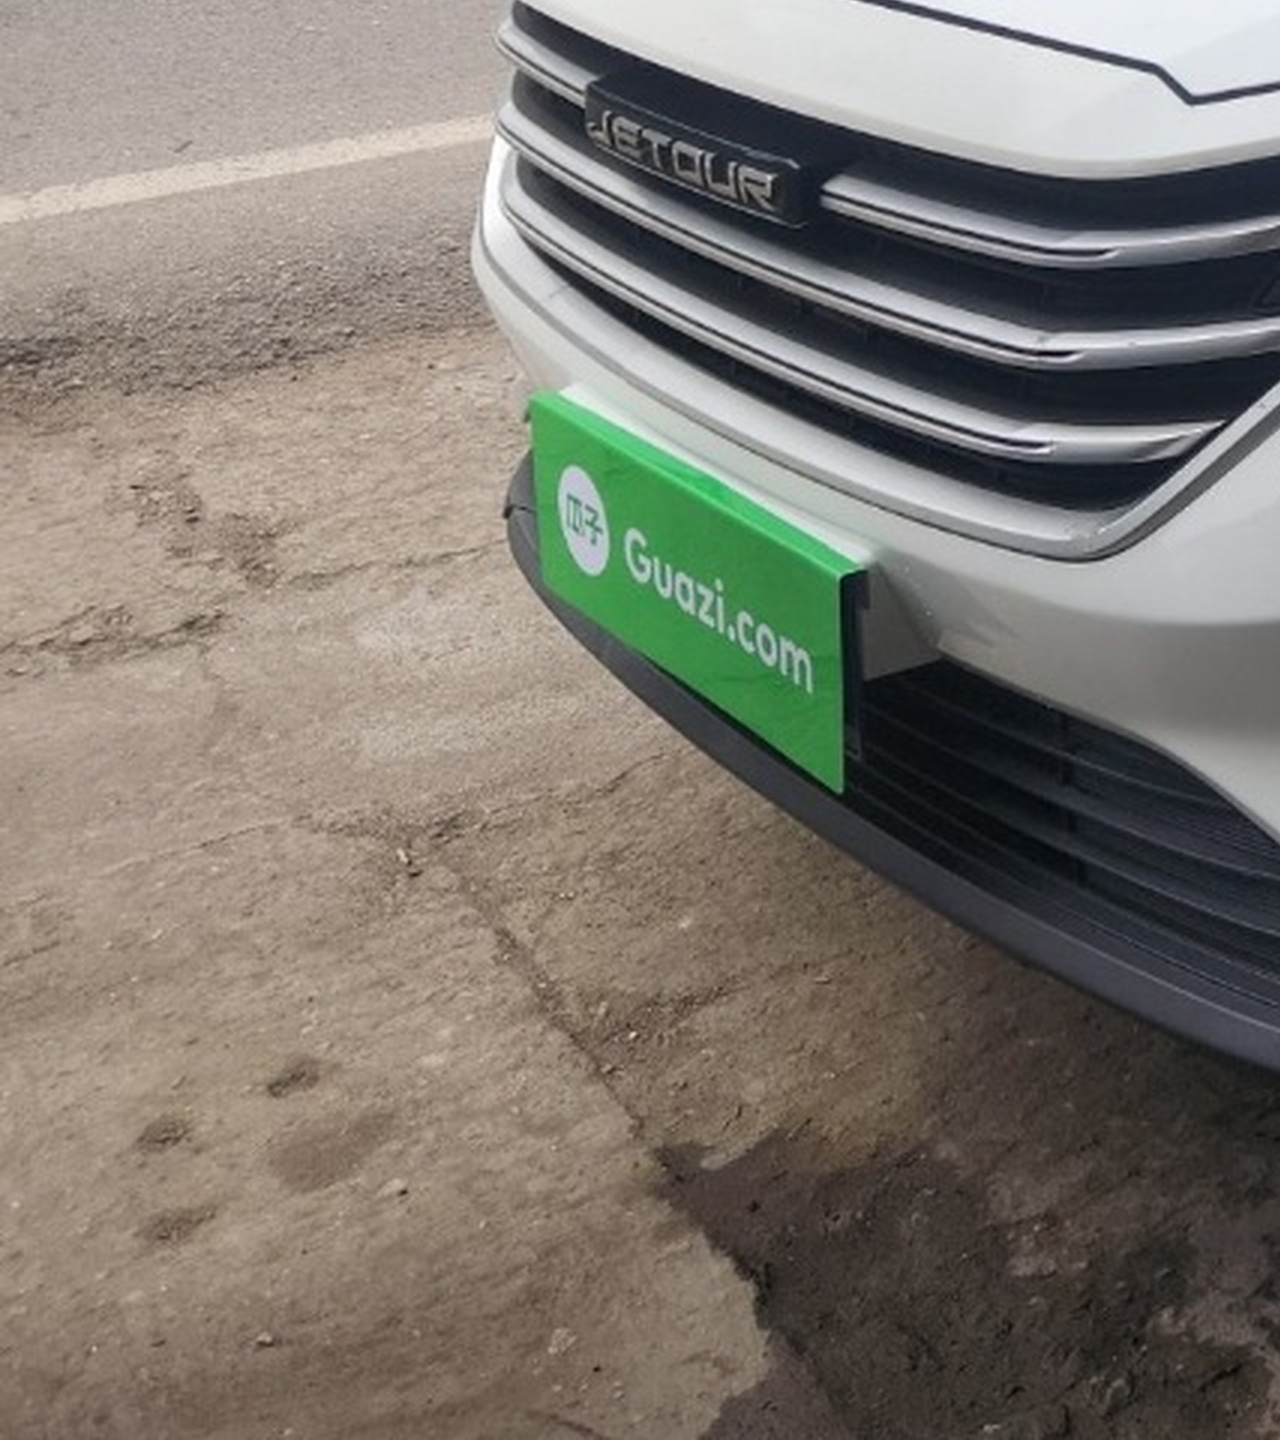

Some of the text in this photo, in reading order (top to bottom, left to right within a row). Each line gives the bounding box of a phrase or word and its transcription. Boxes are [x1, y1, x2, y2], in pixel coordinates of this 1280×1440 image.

[587, 109, 778, 210] JETOUR
[565, 493, 604, 546] 瓜子
[623, 526, 815, 695] Guazi.com
